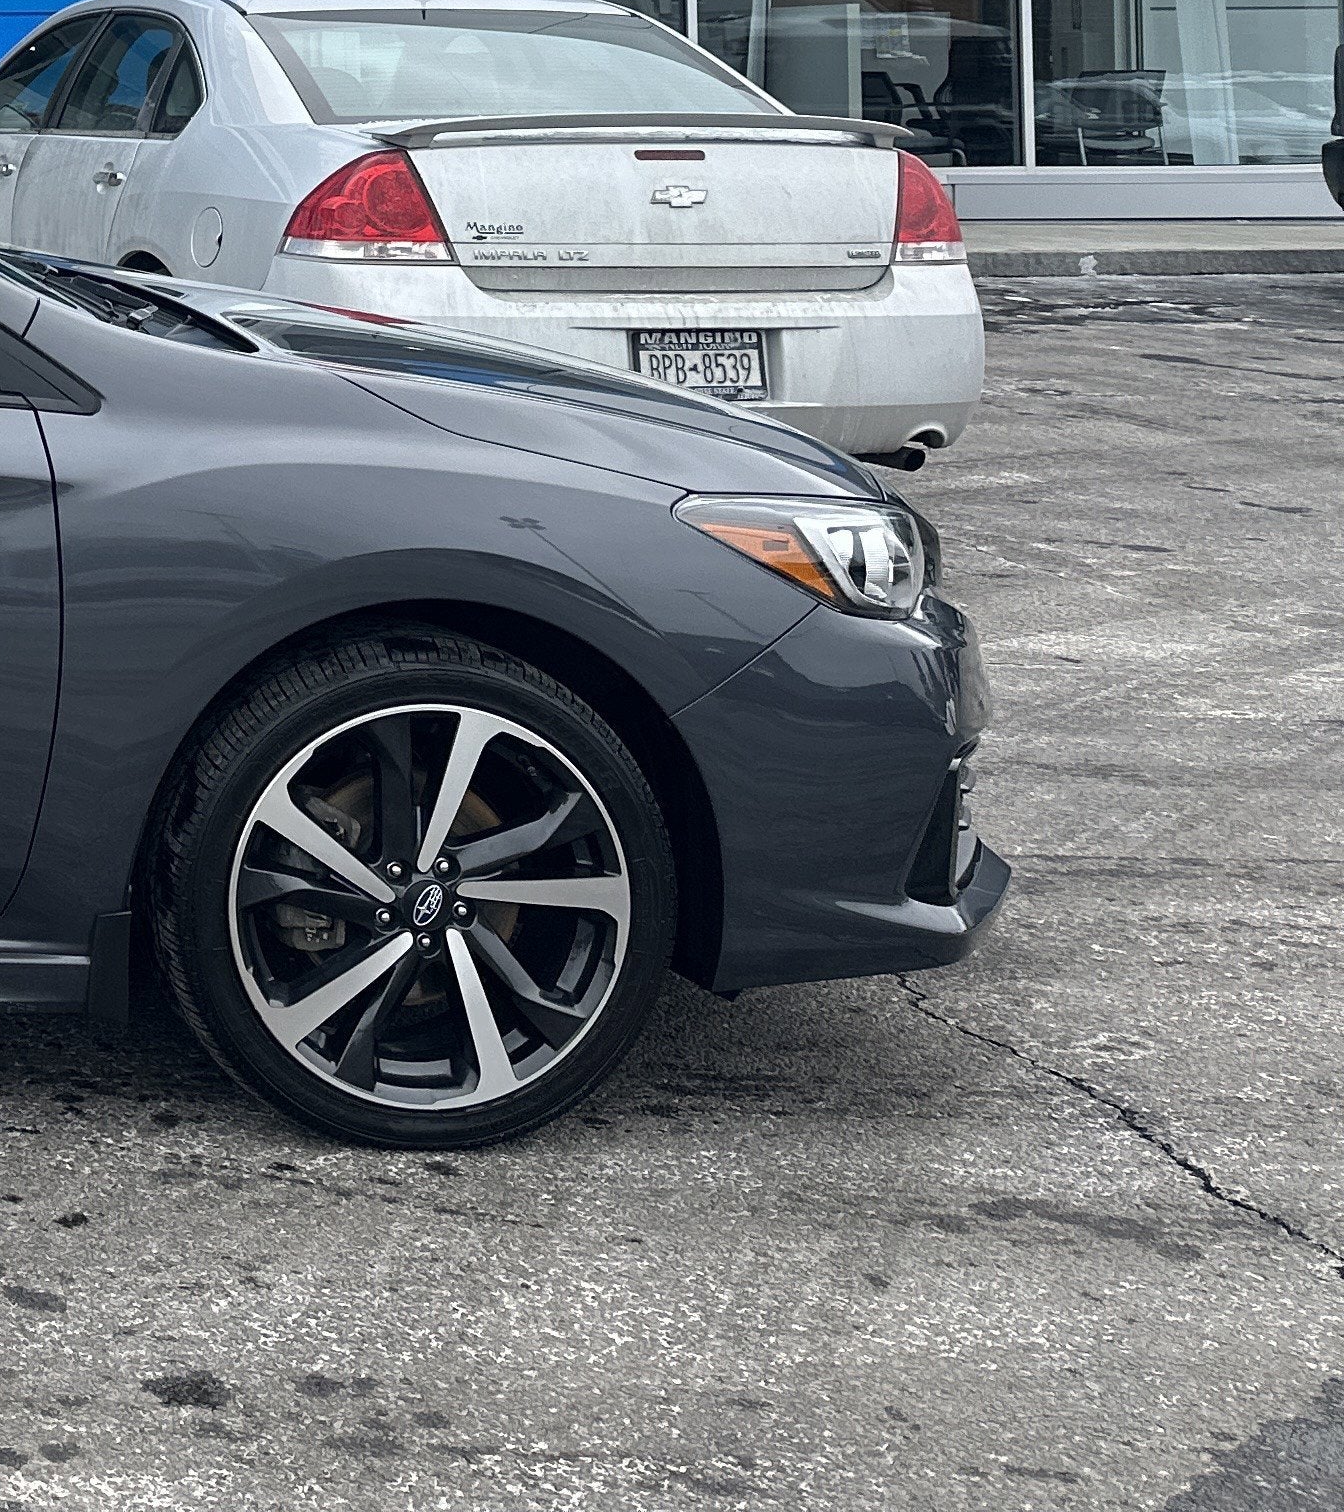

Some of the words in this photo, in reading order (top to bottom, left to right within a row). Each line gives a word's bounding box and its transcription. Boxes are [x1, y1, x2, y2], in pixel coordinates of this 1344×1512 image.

[465, 221, 524, 235] Mangino
[473, 249, 547, 261] IMPALA
[558, 249, 590, 262] LTZ
[639, 331, 758, 344] MANGINO
[702, 353, 752, 384] 8539
